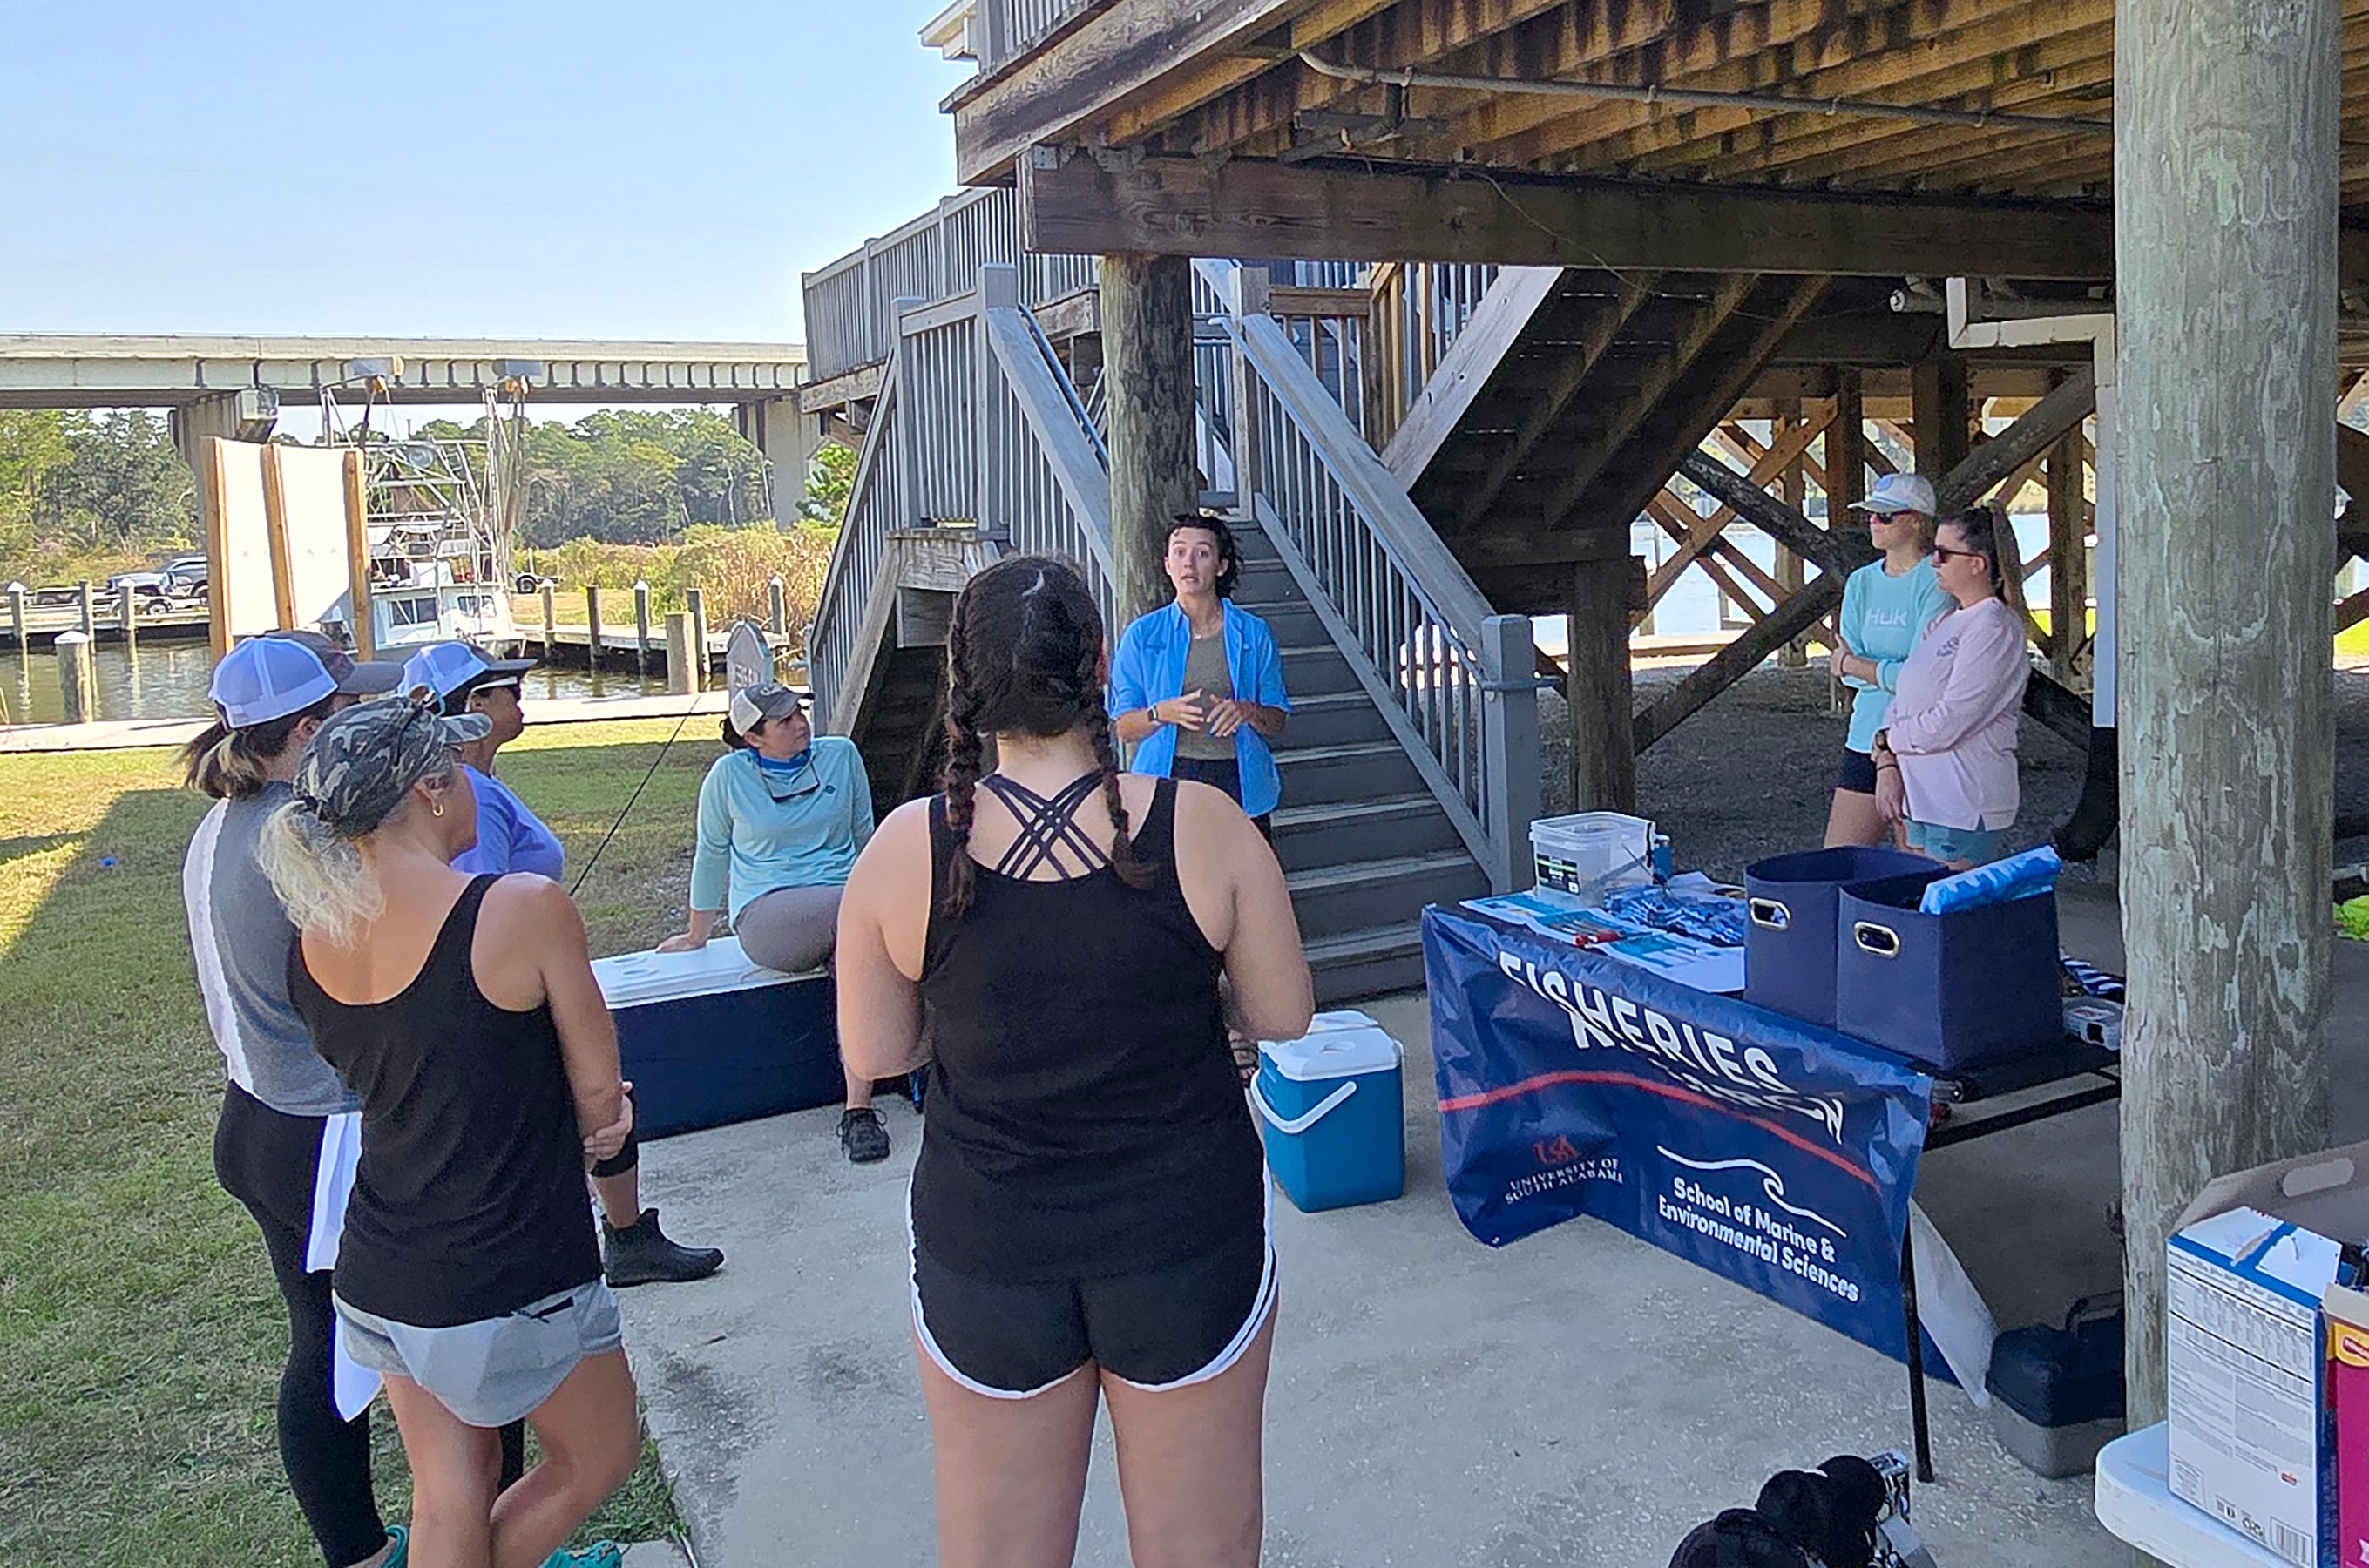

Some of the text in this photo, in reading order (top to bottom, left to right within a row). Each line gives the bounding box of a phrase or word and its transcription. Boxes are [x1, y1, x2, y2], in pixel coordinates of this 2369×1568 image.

[1865, 607, 1908, 626] HUK
[1504, 1168, 1624, 1205] SOUTH ALABAMA
[1510, 1158, 1619, 1191] UNIVERSITY OF
[1674, 1176, 1836, 1263] School of Marine &
[1659, 1194, 1859, 1302] Environmental Sciences
